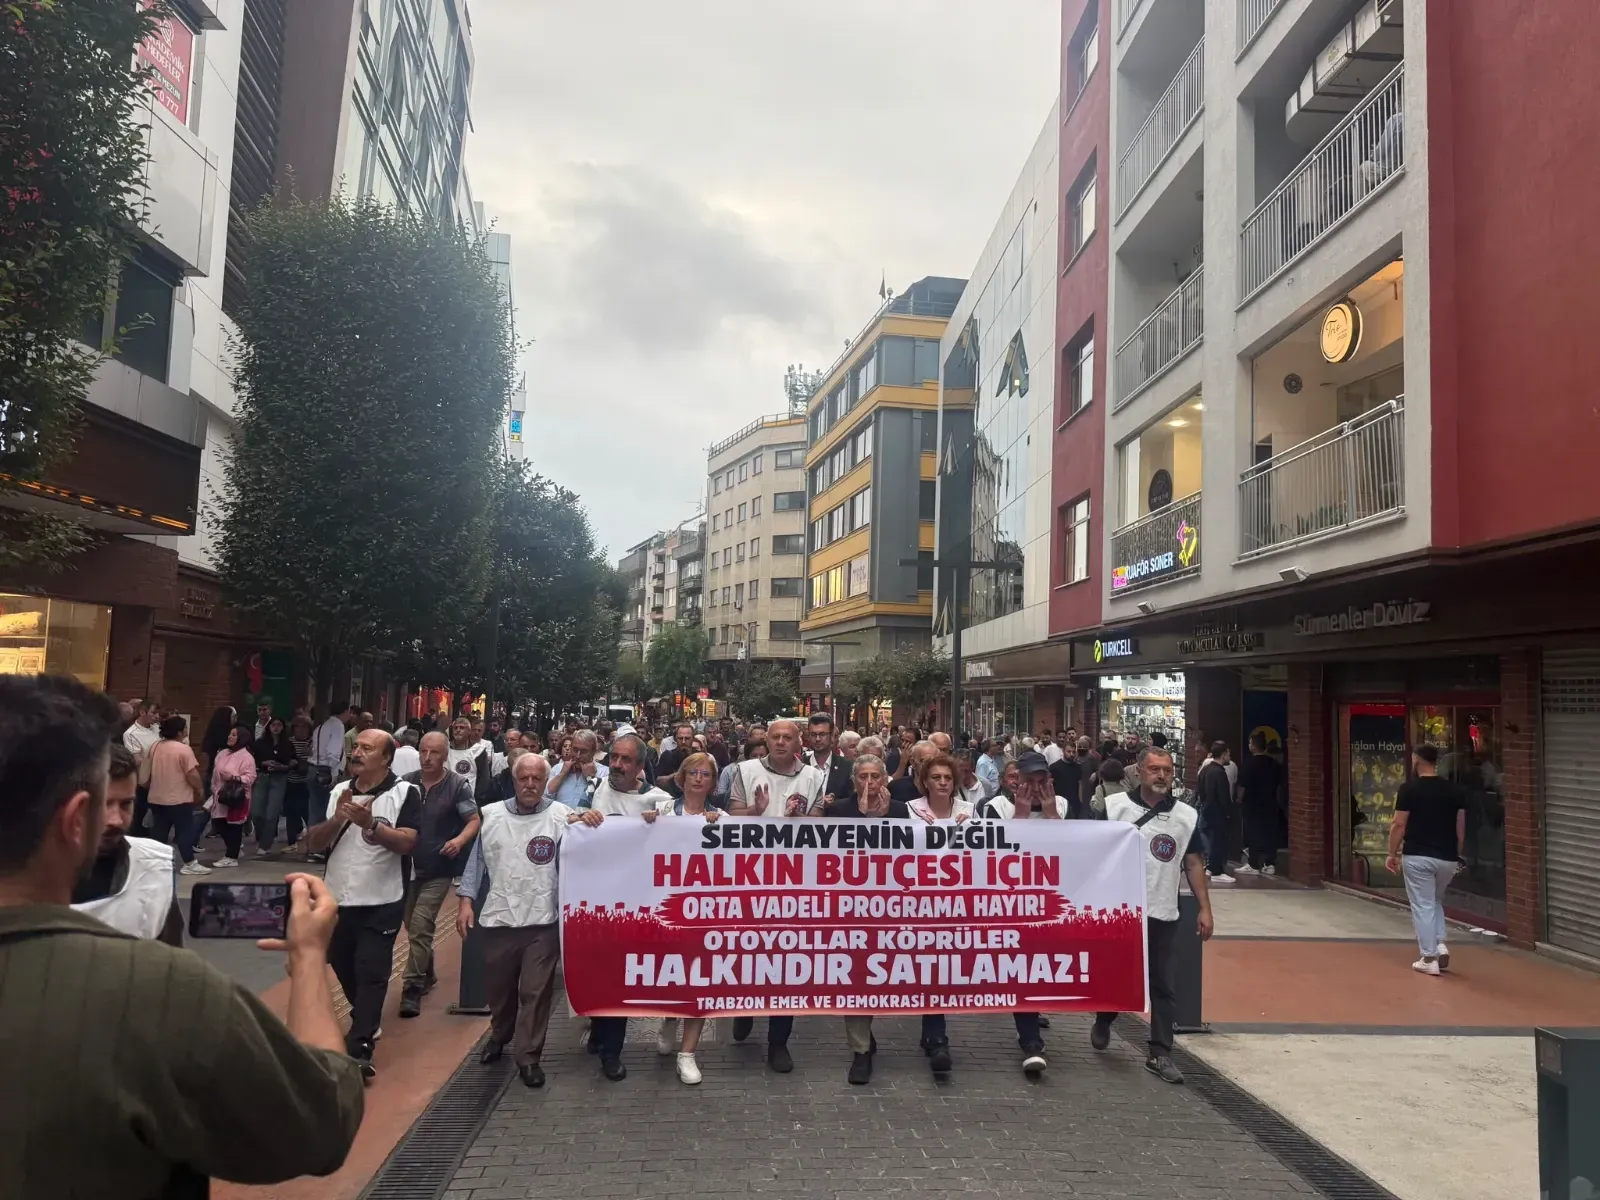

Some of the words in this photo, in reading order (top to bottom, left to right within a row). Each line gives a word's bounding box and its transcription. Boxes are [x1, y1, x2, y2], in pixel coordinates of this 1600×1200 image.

[145, 34, 184, 73] KADEMİK
[147, 41, 181, 82] HEDEFLER
[162, 77, 181, 101] MEZUN
[1150, 551, 1173, 573] SONER
[1294, 605, 1372, 637] Sürmenler
[1373, 597, 1431, 627] Döviz
[1102, 638, 1133, 658] TURKCELL
[701, 821, 914, 849] SERMAYENİN
[926, 821, 1020, 852] DEĞİL,
[653, 853, 804, 887] HALKIN
[816, 851, 973, 892] BÜTÇESİ
[987, 851, 1060, 891] İÇİN
[682, 896, 743, 919] ORTA
[751, 892, 831, 919] VADELİ
[838, 895, 967, 918] PROGRAMA
[973, 894, 1046, 917] HAYIR!
[704, 930, 868, 951] OTOYOLLAR
[877, 926, 1021, 950] KÖPRÜLER
[624, 953, 853, 987] HALKINDIR
[866, 952, 1090, 986] SATILAMAZ!
[697, 997, 765, 1010] TRABZON
[770, 996, 809, 1009] EMEK
[813, 995, 831, 1009] VE
[836, 993, 925, 1008] DEMOKRASİ
[930, 994, 1017, 1007] PLATFORMU
